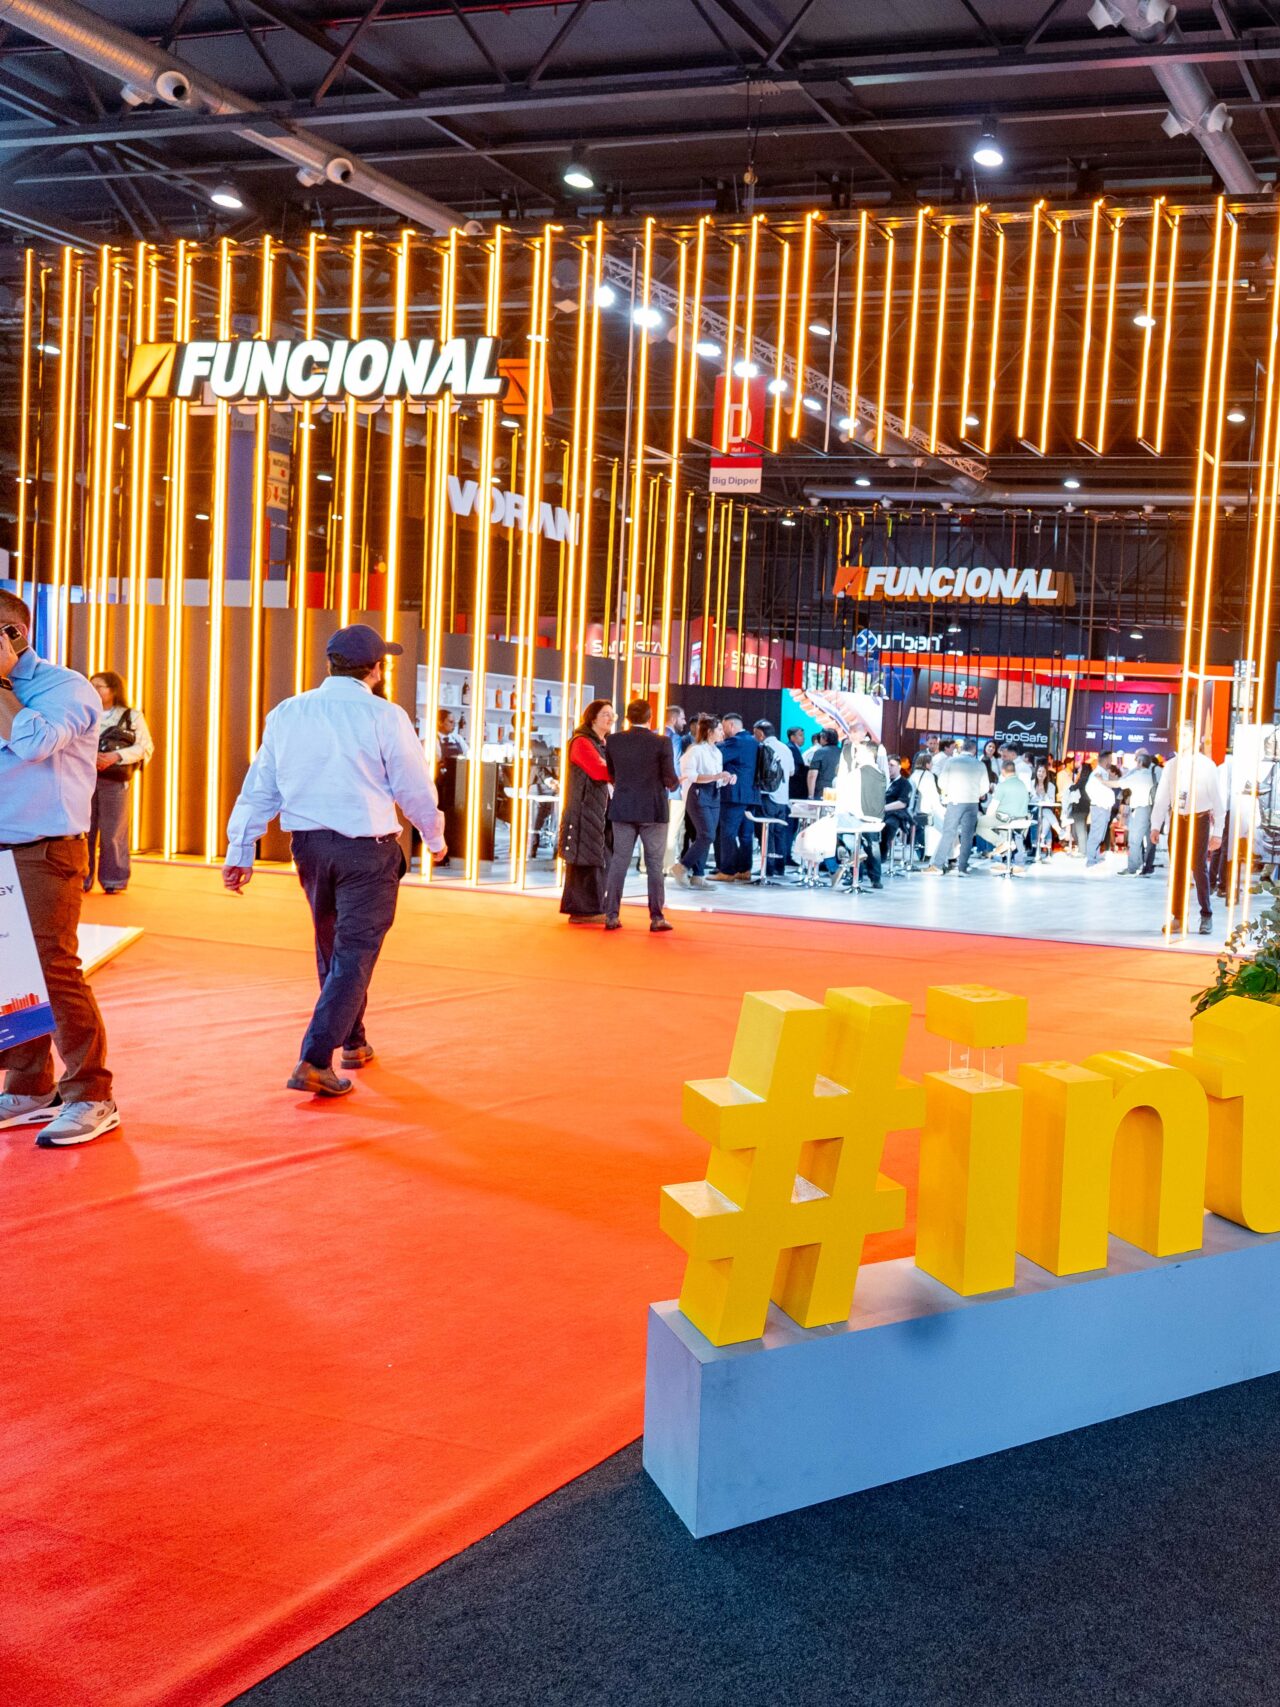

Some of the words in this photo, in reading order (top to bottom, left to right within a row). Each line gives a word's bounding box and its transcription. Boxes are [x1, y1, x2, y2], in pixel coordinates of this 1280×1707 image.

[177, 337, 502, 397] FUNCIONAL
[727, 403, 753, 444] D
[712, 476, 726, 486] Big
[728, 476, 758, 486] Dipper
[864, 566, 1059, 600] FUNCIONAL
[994, 731, 1049, 744] ErgoSafe
